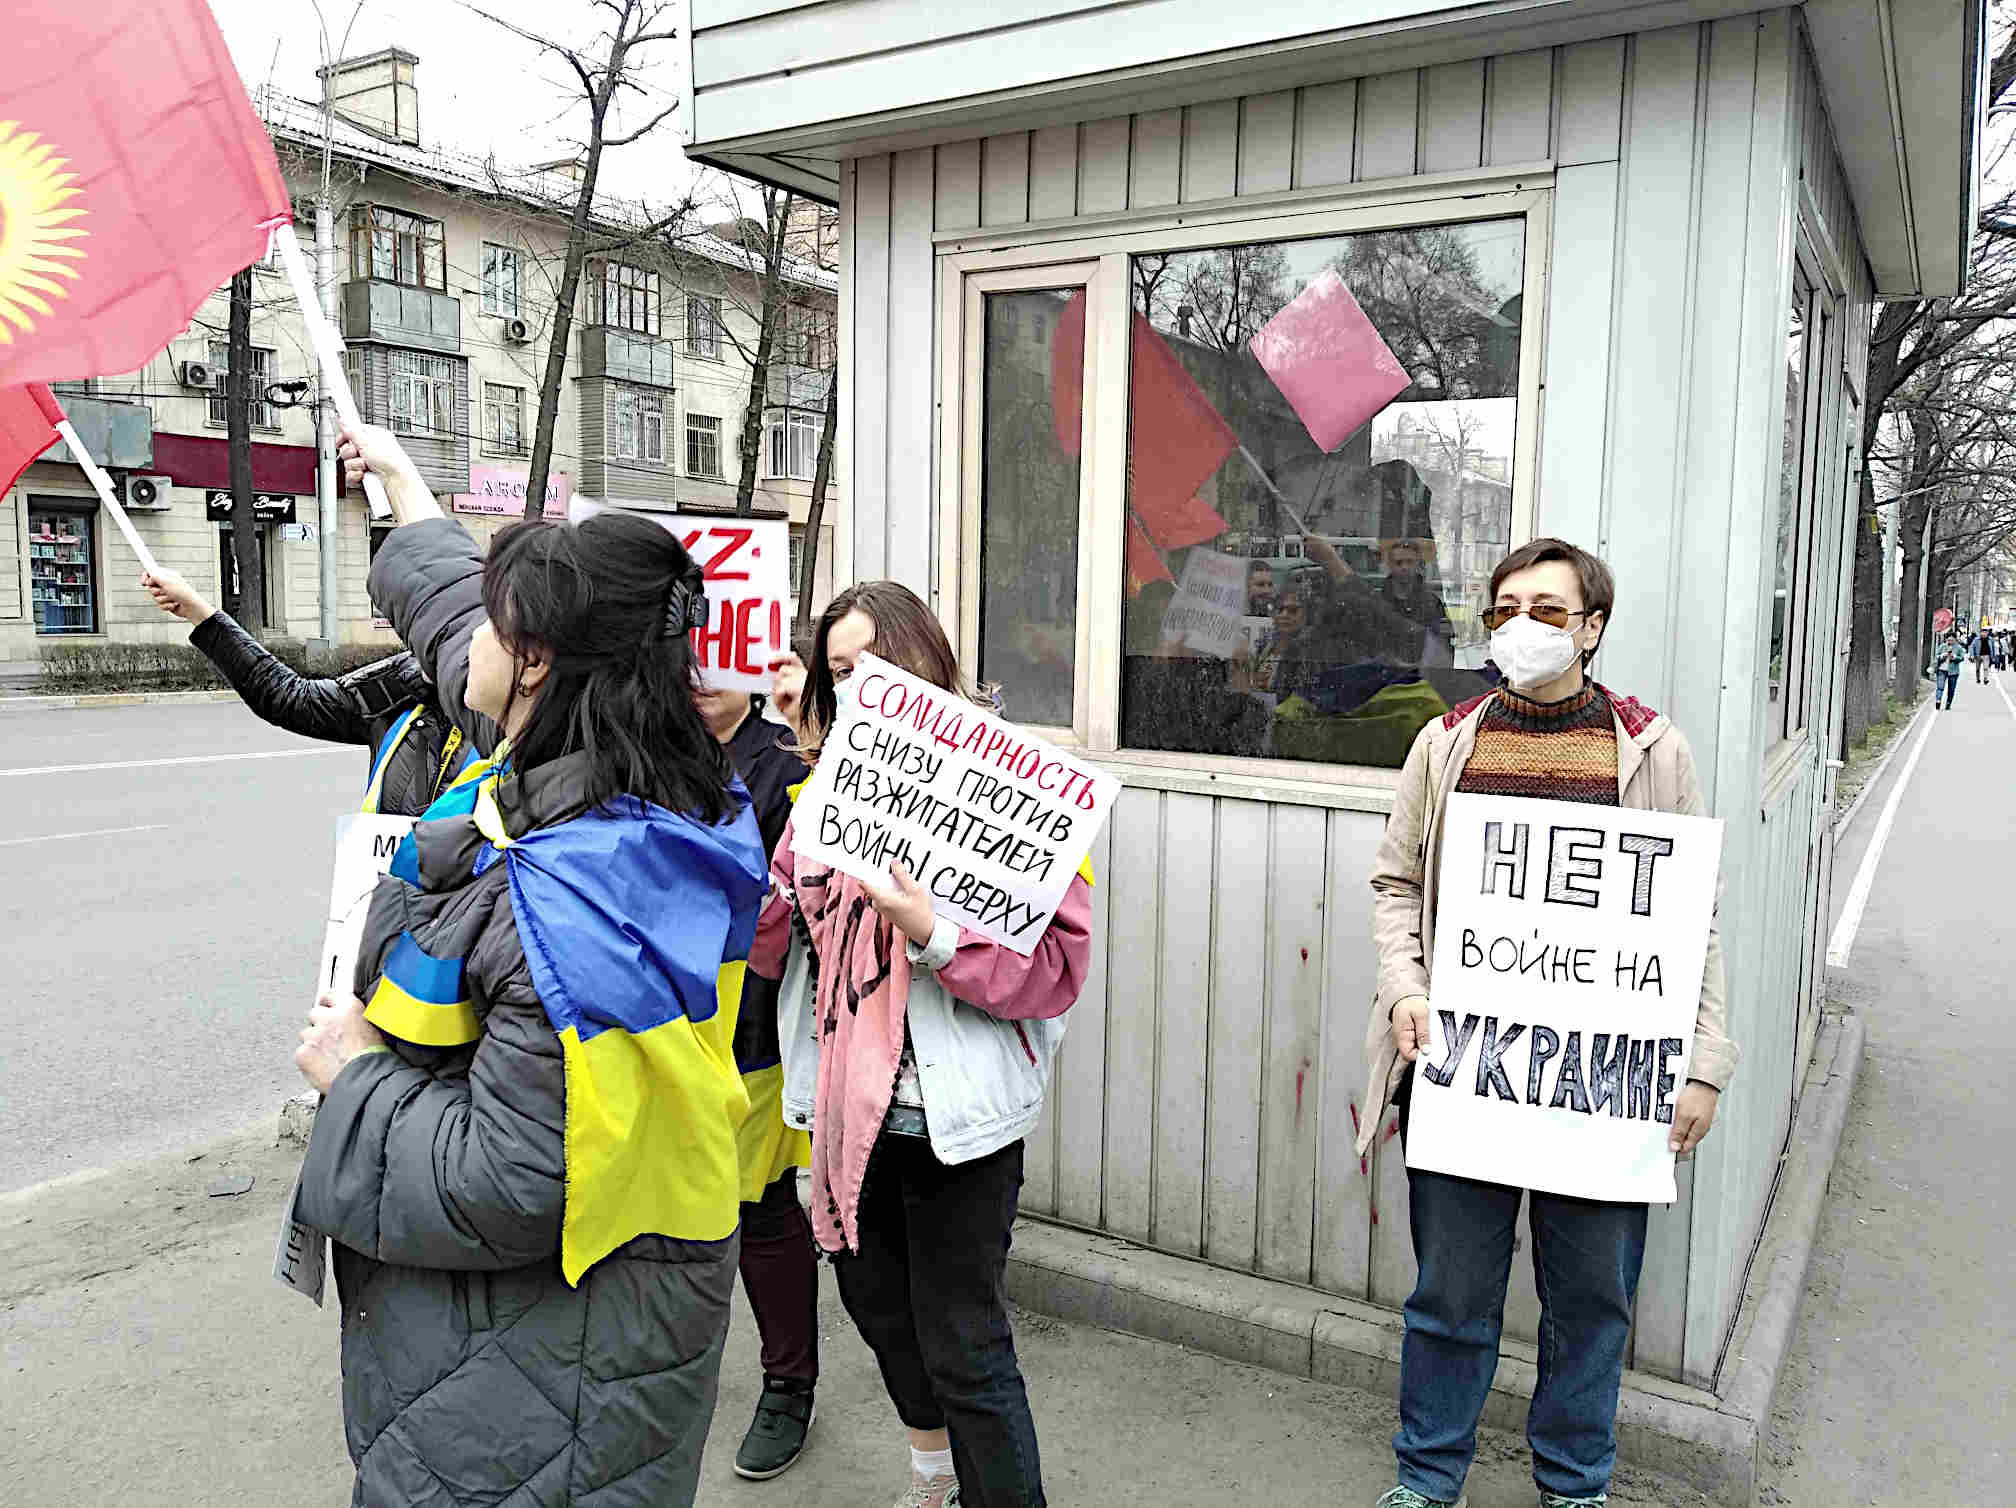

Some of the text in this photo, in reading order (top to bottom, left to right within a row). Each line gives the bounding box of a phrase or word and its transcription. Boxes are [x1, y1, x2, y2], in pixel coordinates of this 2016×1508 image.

[847, 721, 1072, 843] СНИЗУ ПРОТИВ
[858, 673, 1095, 811] СОЛИДАРНОСТЬ
[818, 804, 1046, 937] ВОЙНЫ СВЕРХУ
[833, 758, 1056, 883] РАЗЖИГАТЕЛЕЙ
[1480, 821, 1674, 917] НЕТ
[1461, 928, 1664, 997] ВОЙНЕ НА
[1421, 1009, 1683, 1125] УКРАИНЕ
